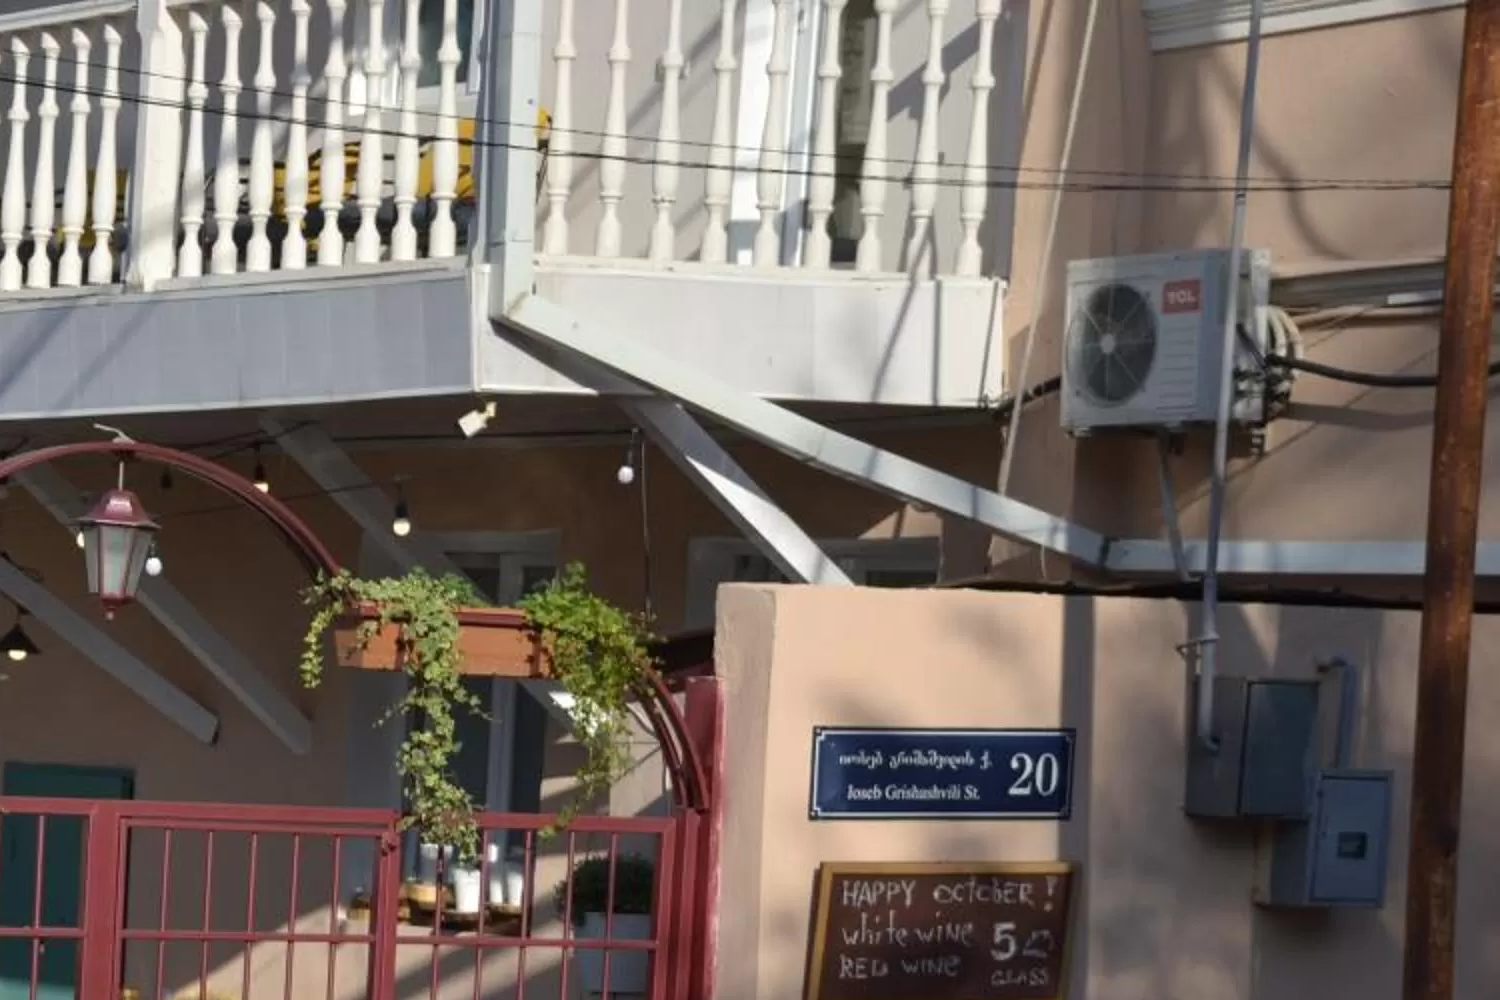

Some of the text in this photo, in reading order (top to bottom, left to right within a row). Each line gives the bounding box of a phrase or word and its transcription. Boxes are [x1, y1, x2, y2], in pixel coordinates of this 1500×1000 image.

[1008, 752, 1059, 797] 20
[842, 879, 917, 908] HAPPY
[841, 909, 908, 948] white
[838, 953, 889, 980] RED
